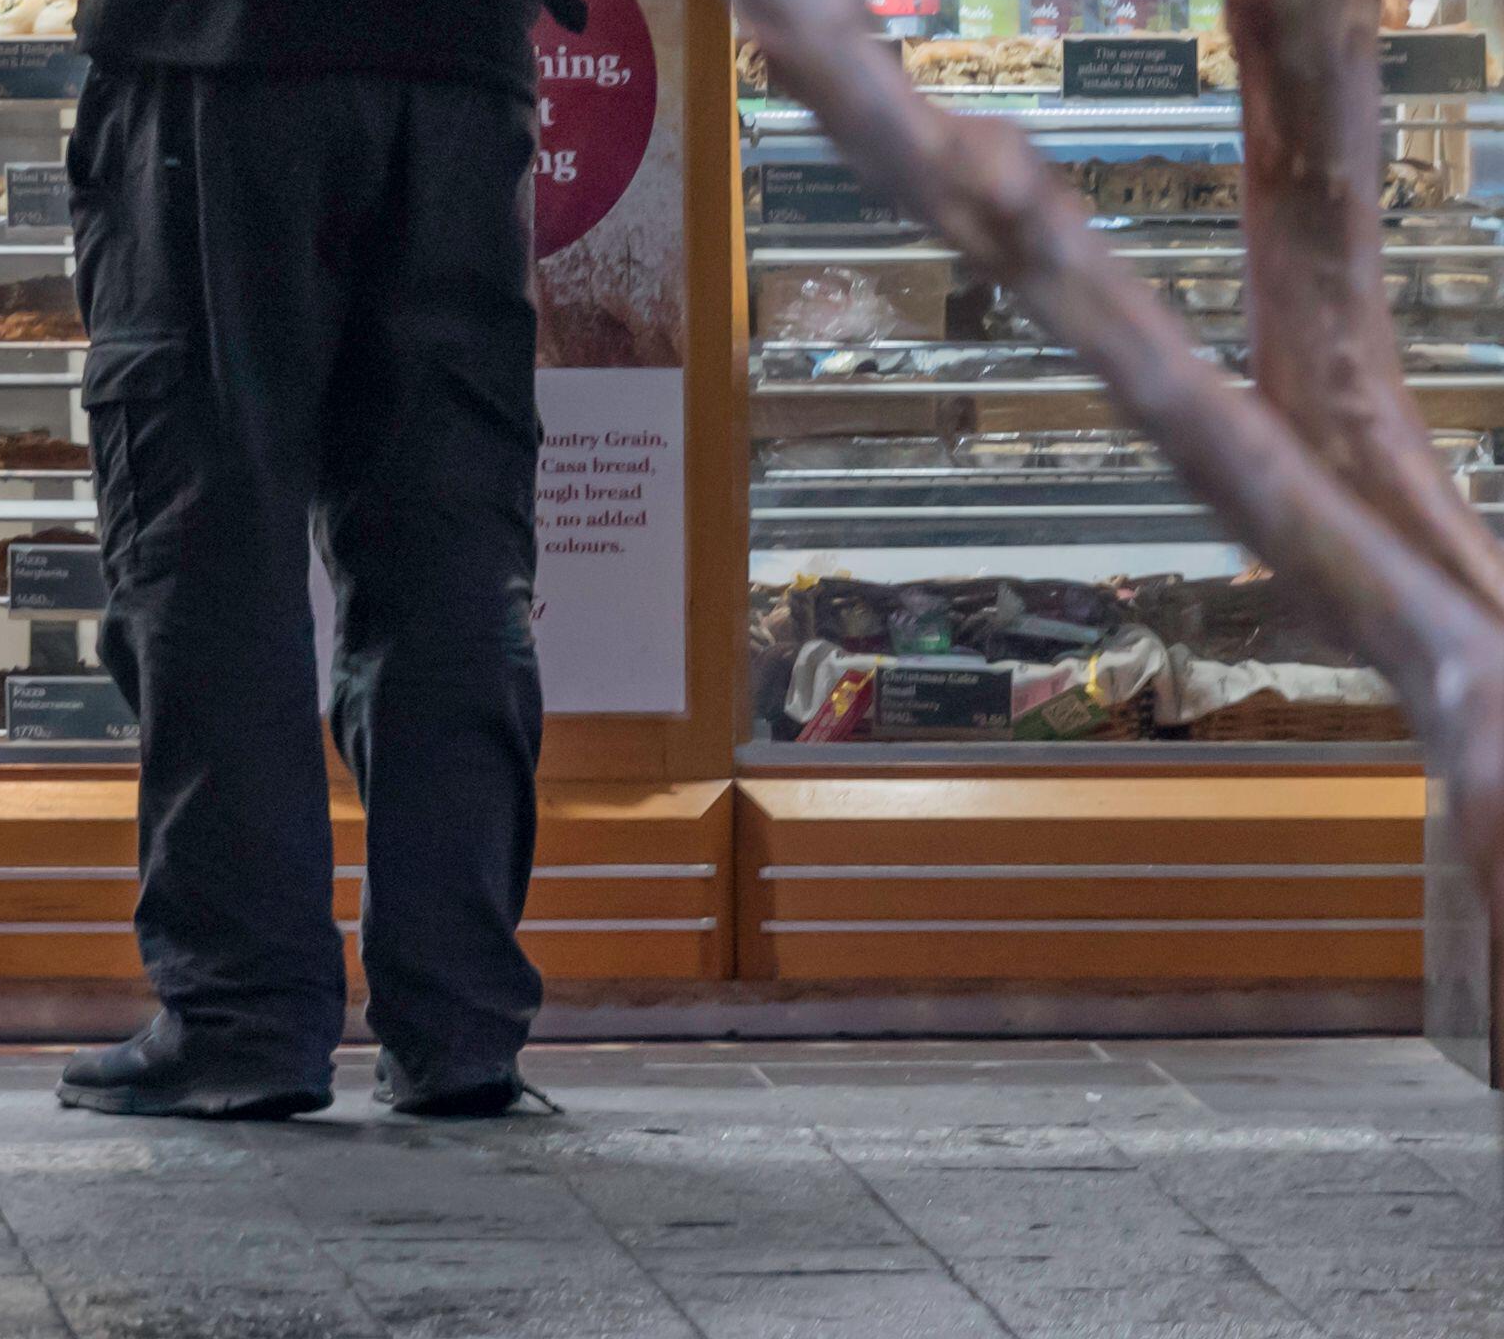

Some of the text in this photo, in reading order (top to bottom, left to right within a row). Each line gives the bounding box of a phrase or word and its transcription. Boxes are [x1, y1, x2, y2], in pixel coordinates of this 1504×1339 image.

[1096, 48, 1166, 61] The average
[535, 44, 633, 88] hing,
[1142, 64, 1184, 76] energy
[12, 172, 41, 183] Mini
[544, 430, 669, 451] untry Grain,
[540, 456, 656, 476] Casa bread,
[584, 483, 643, 501] bread
[554, 510, 648, 528] no added
[543, 536, 626, 554] colours.
[15, 554, 48, 565] Pizza
[14, 686, 46, 697] Pizza
